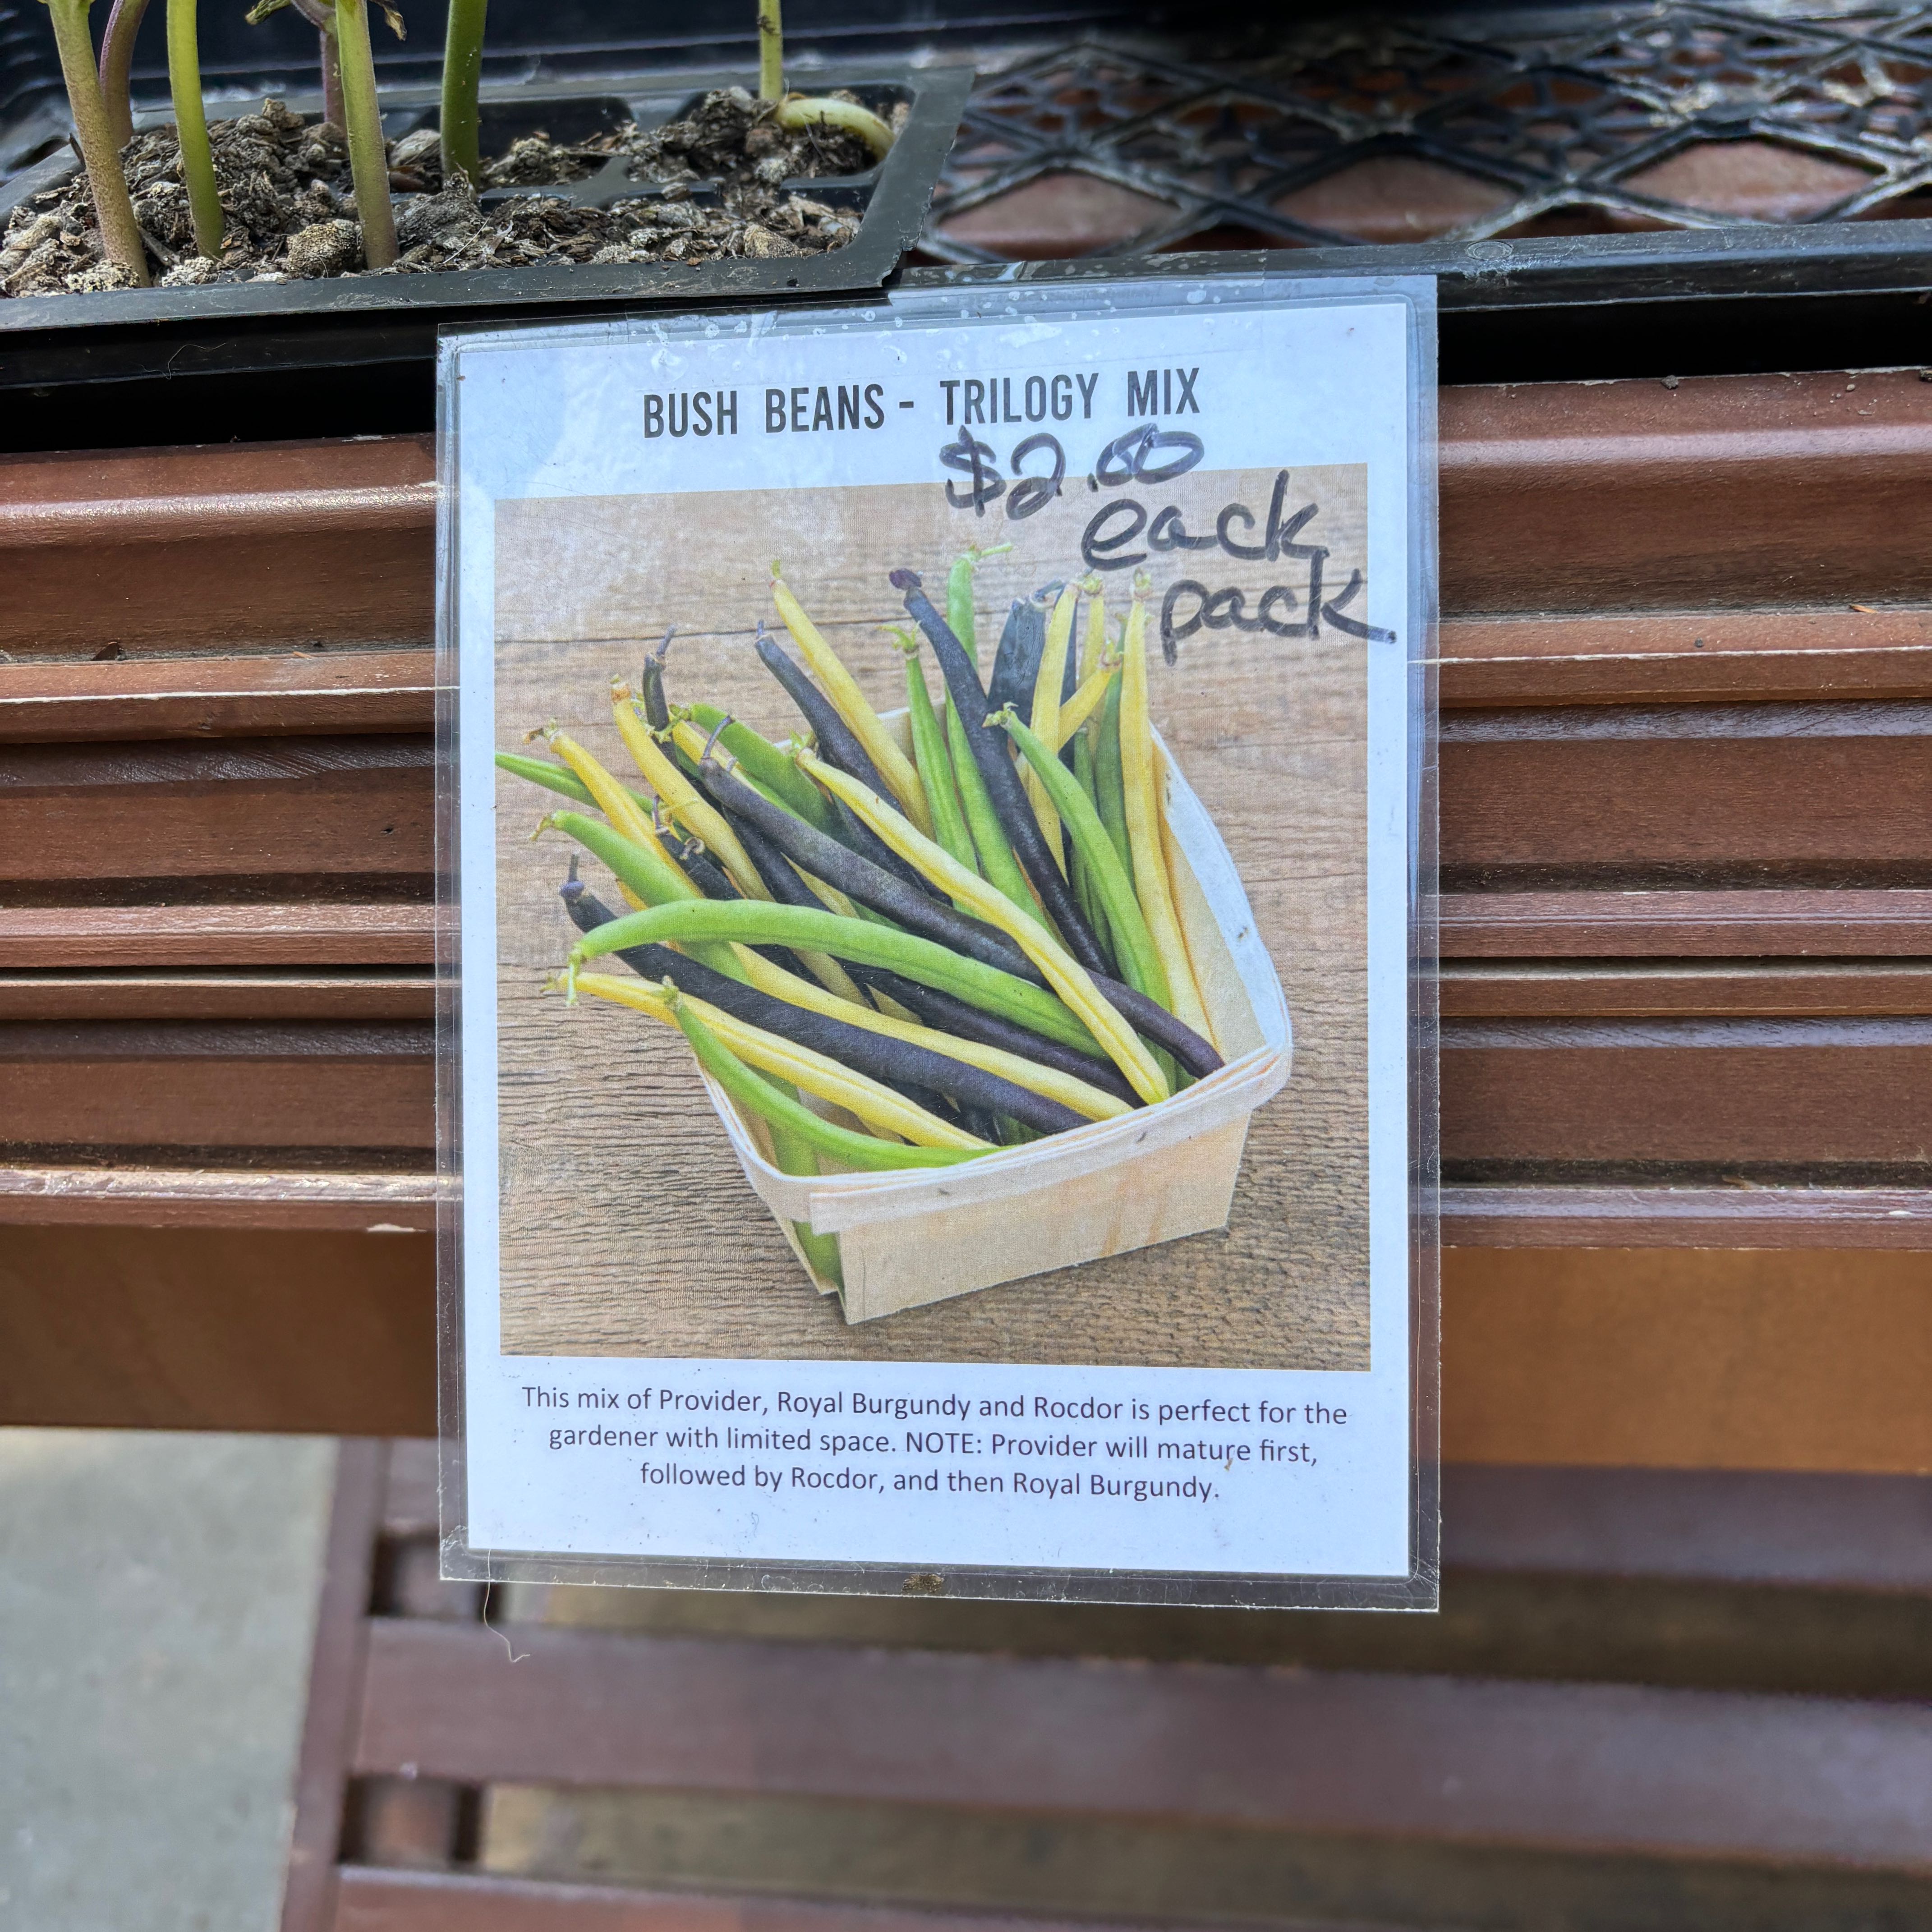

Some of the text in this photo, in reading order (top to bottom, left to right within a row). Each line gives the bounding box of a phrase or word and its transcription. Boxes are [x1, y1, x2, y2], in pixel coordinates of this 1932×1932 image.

[644, 391, 737, 438] BUSH
[940, 373, 1099, 425] TRILOGY
[1128, 368, 1200, 416] MIX
[939, 422, 1205, 520] $2.00
[1160, 547, 1397, 666] pack
[522, 1386, 1347, 1425] This mix of Provider, Royal Burgundy and Rocdor is perfect for the
[550, 1425, 1316, 1466] gardener with limited space. NOTE: Provider will mature first,
[641, 1463, 1219, 1503] followed by Rocdor, and then Royal Burgundy.
